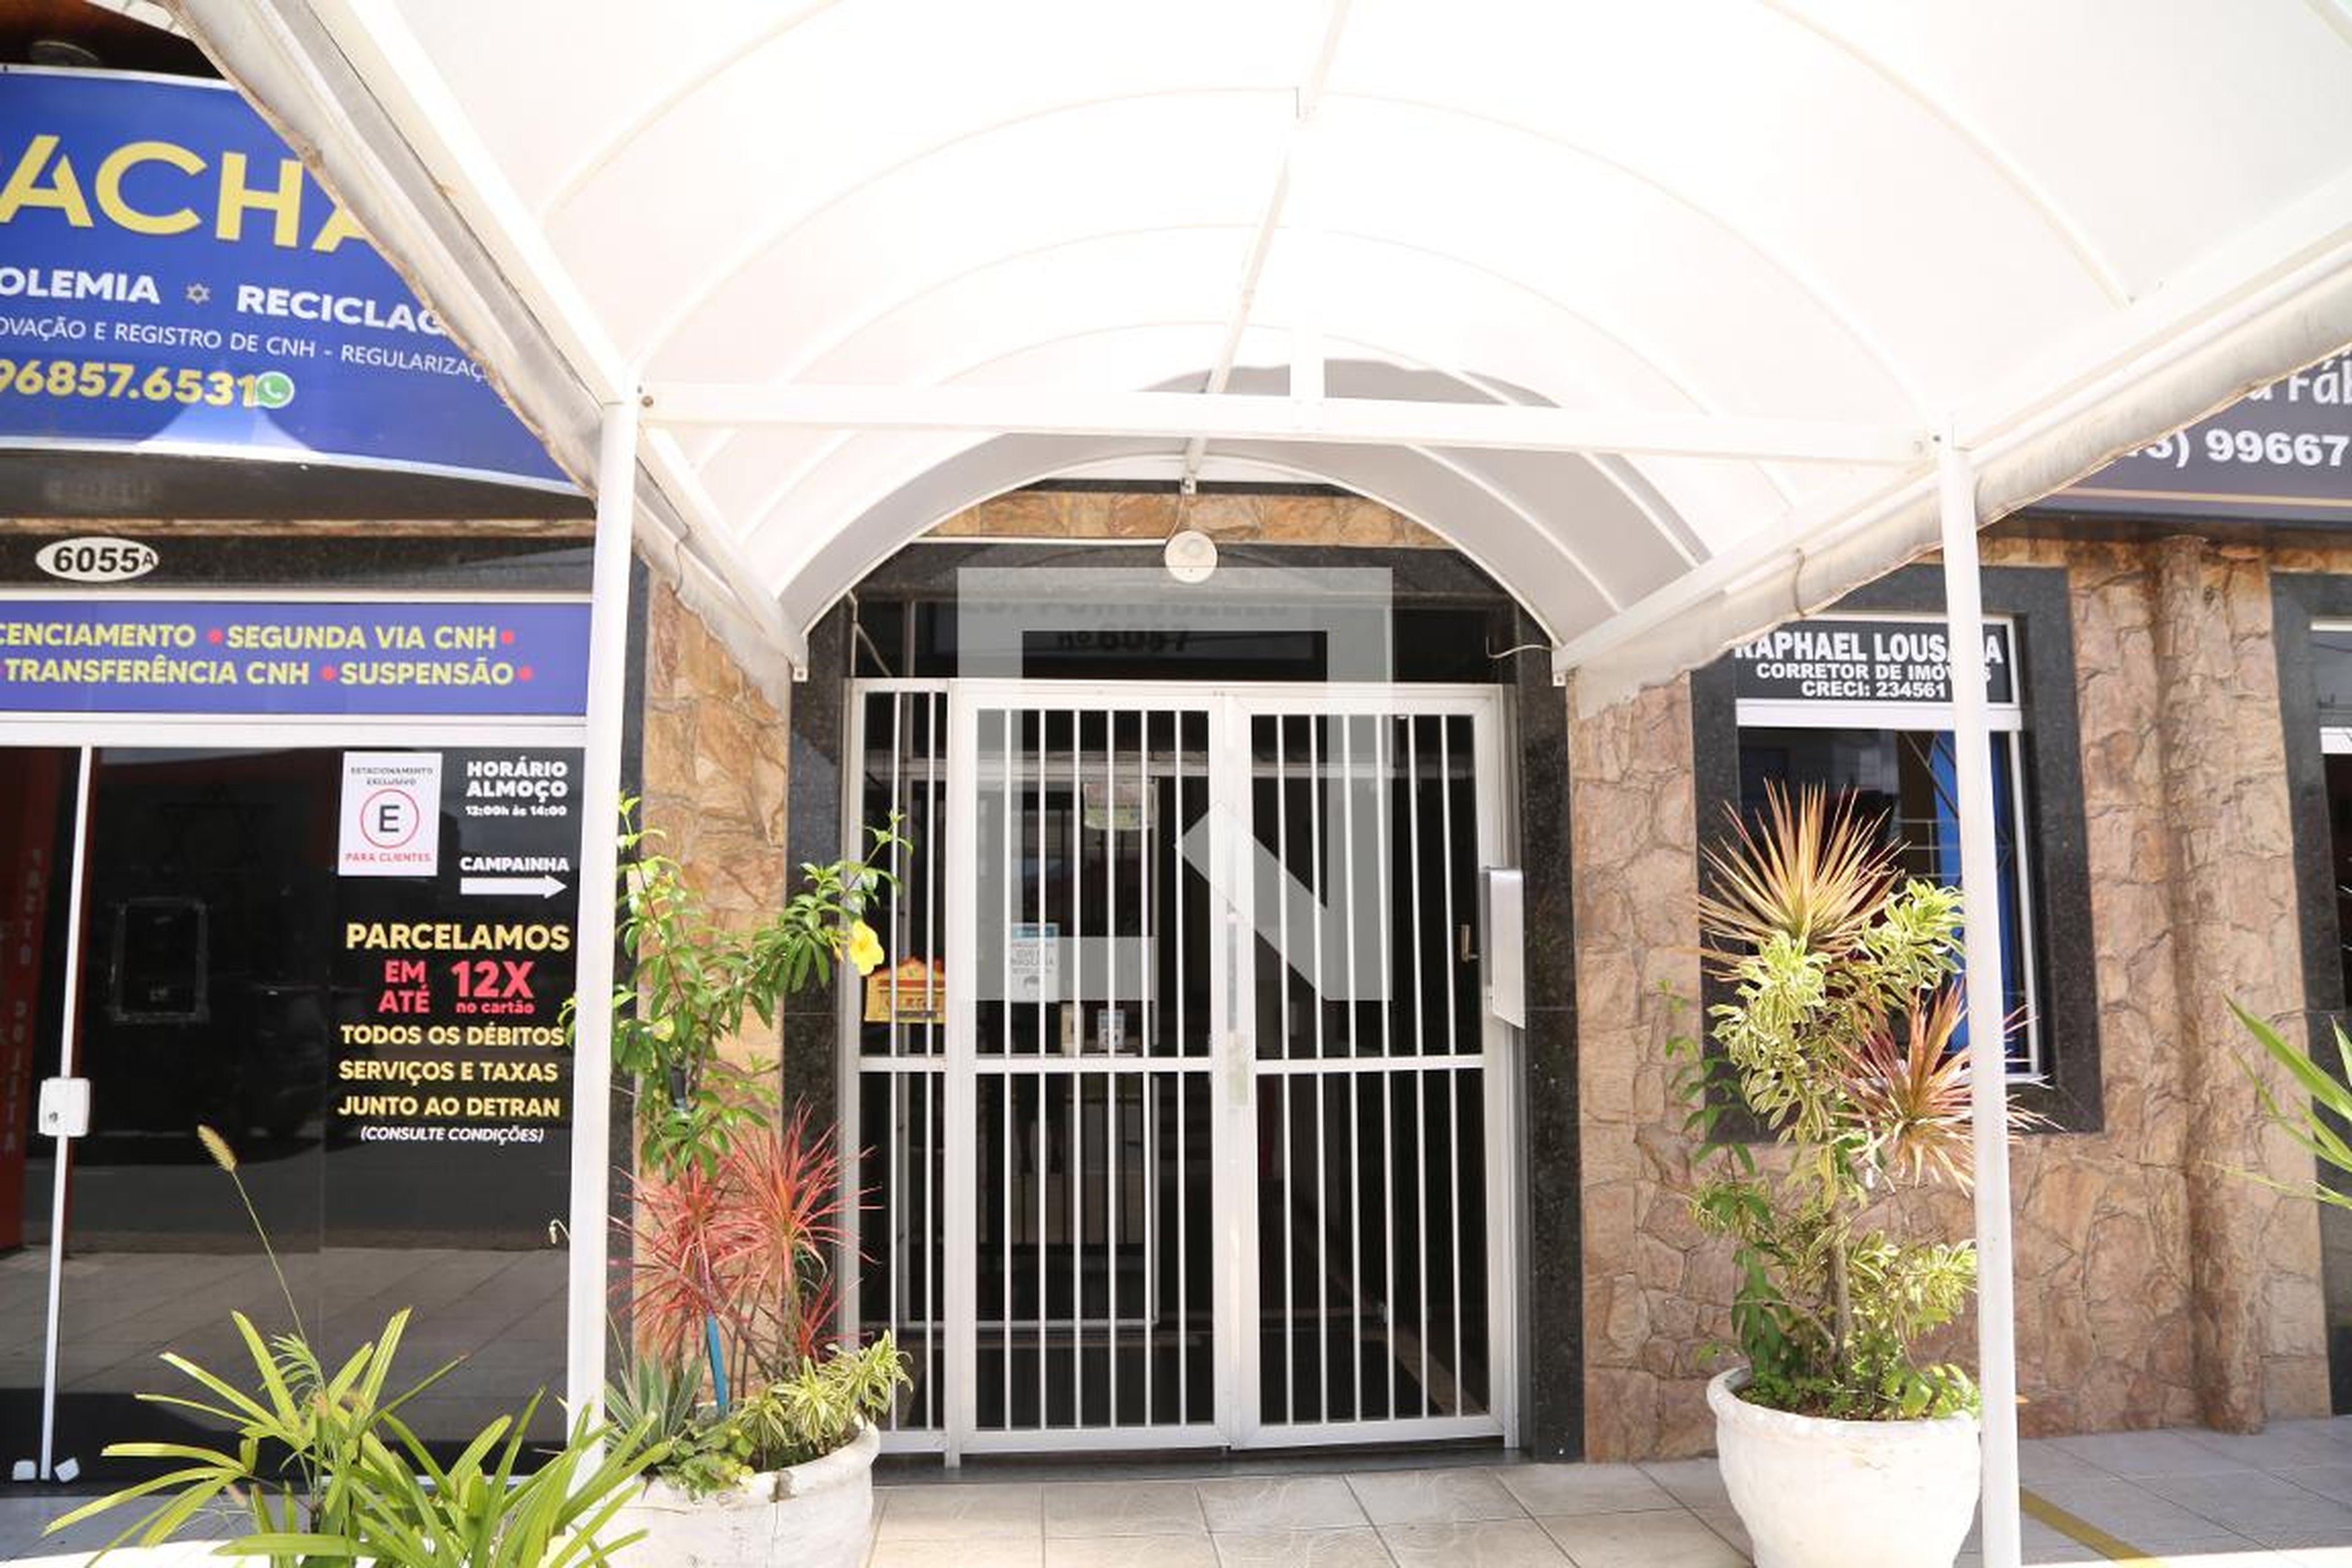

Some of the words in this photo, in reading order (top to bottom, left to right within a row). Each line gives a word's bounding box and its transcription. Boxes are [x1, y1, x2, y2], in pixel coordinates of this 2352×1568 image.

[0, 267, 160, 304] OLEMIA
[94, 322, 106, 339] E
[115, 323, 222, 349] REGISTRO
[230, 333, 258, 352] DE
[266, 337, 315, 358] CNH
[2206, 428, 2350, 467] 99667
[0, 622, 197, 647] ENCIAMENTO
[227, 625, 366, 649] SEGUNDA
[374, 625, 425, 648] VIA
[434, 625, 496, 649] CNH
[5, 654, 238, 684] TRANSFERÊNCIA
[247, 662, 309, 684] CNH
[340, 657, 514, 685] SUSPENSÃO
[1756, 663, 1869, 680] CORRETOR
[1875, 665, 1902, 680] DE
[1801, 681, 1871, 697] CRECI:
[1875, 682, 1947, 698] 234561
[466, 756, 568, 778] HORÁRIO
[466, 780, 568, 802] ALMOÇO
[379, 805, 400, 832] E
[466, 805, 510, 816] 12:00h
[513, 804, 528, 816] às
[531, 805, 567, 816] 14:00
[345, 853, 375, 862] PARA
[379, 853, 432, 862] CLIENTES
[460, 857, 570, 872] CAMPAINHA
[345, 923, 570, 951] PARCELAMOS
[385, 960, 426, 983] EM
[450, 960, 535, 998] 12X
[378, 984, 430, 1014] ATÉ
[455, 1003, 478, 1014] no
[481, 1000, 535, 1014] cartão
[341, 1024, 421, 1045] TODOS
[428, 1026, 460, 1045] OS
[467, 1022, 565, 1046] DÉBITOS
[339, 1060, 454, 1086] SERVIÇOS
[461, 1062, 473, 1080] E
[480, 1062, 559, 1082] TAXAS
[337, 1096, 418, 1115] JUNTO
[424, 1097, 459, 1115] AO
[467, 1098, 560, 1117] DETRAN
[360, 1126, 446, 1141] (CONSULTE
[448, 1125, 544, 1145] CONDIÇÕES)
